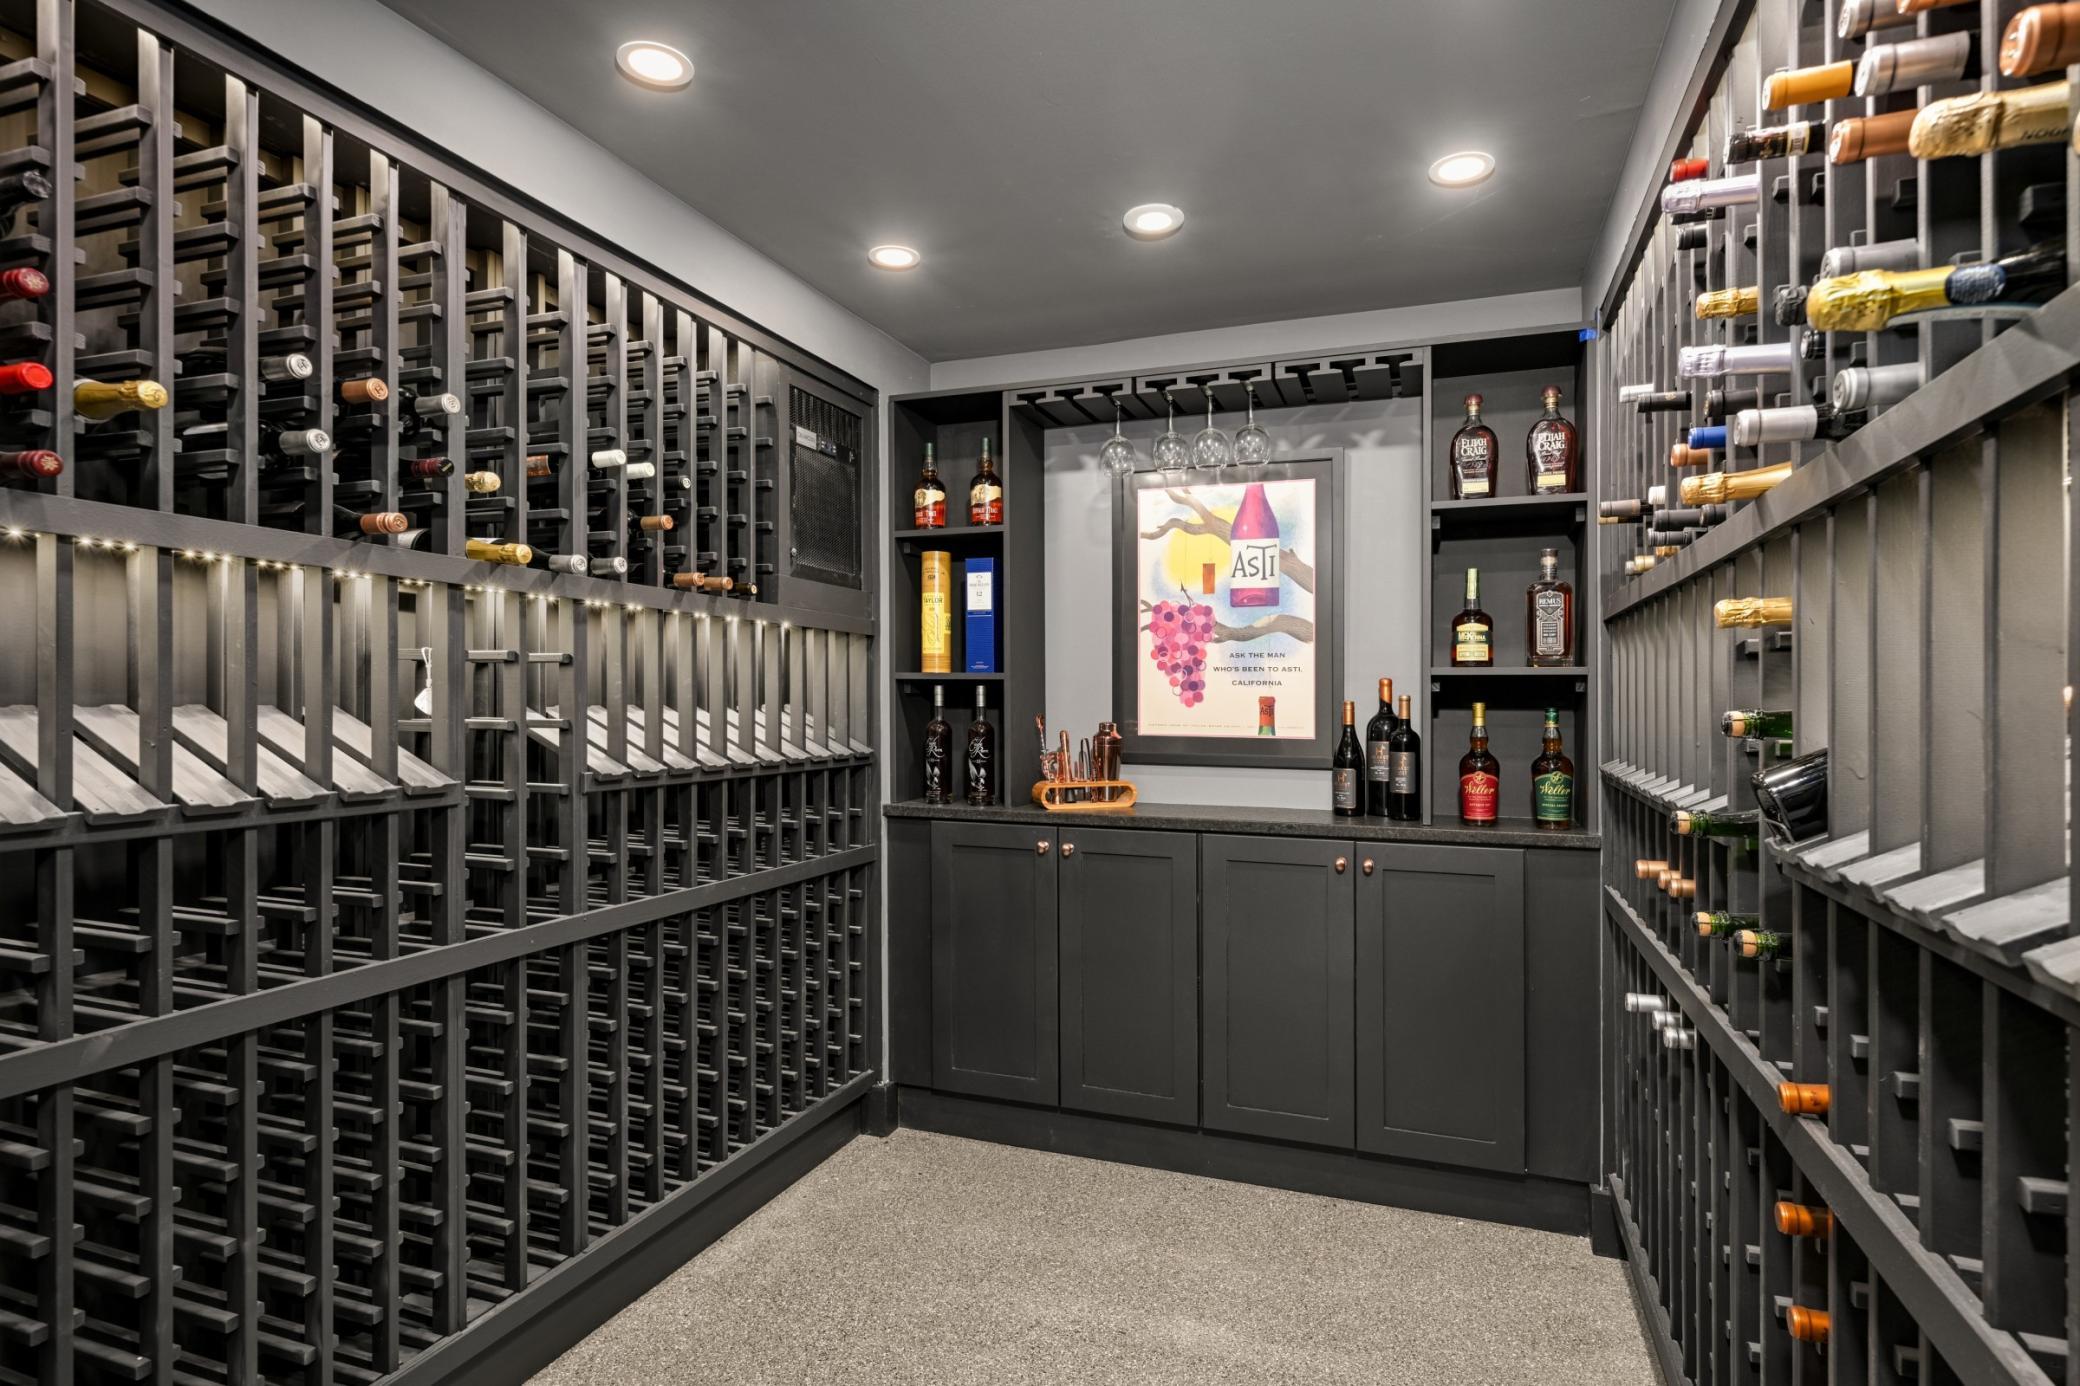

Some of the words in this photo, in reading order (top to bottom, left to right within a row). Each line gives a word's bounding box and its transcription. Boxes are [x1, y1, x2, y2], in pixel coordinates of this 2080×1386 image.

[1461, 438, 1487, 447] ELIJAH
[1538, 441, 1565, 450] CRAIG
[1461, 447, 1487, 456] CRAIG
[1464, 781, 1495, 795] Weller
[1540, 781, 1571, 795] Weller
